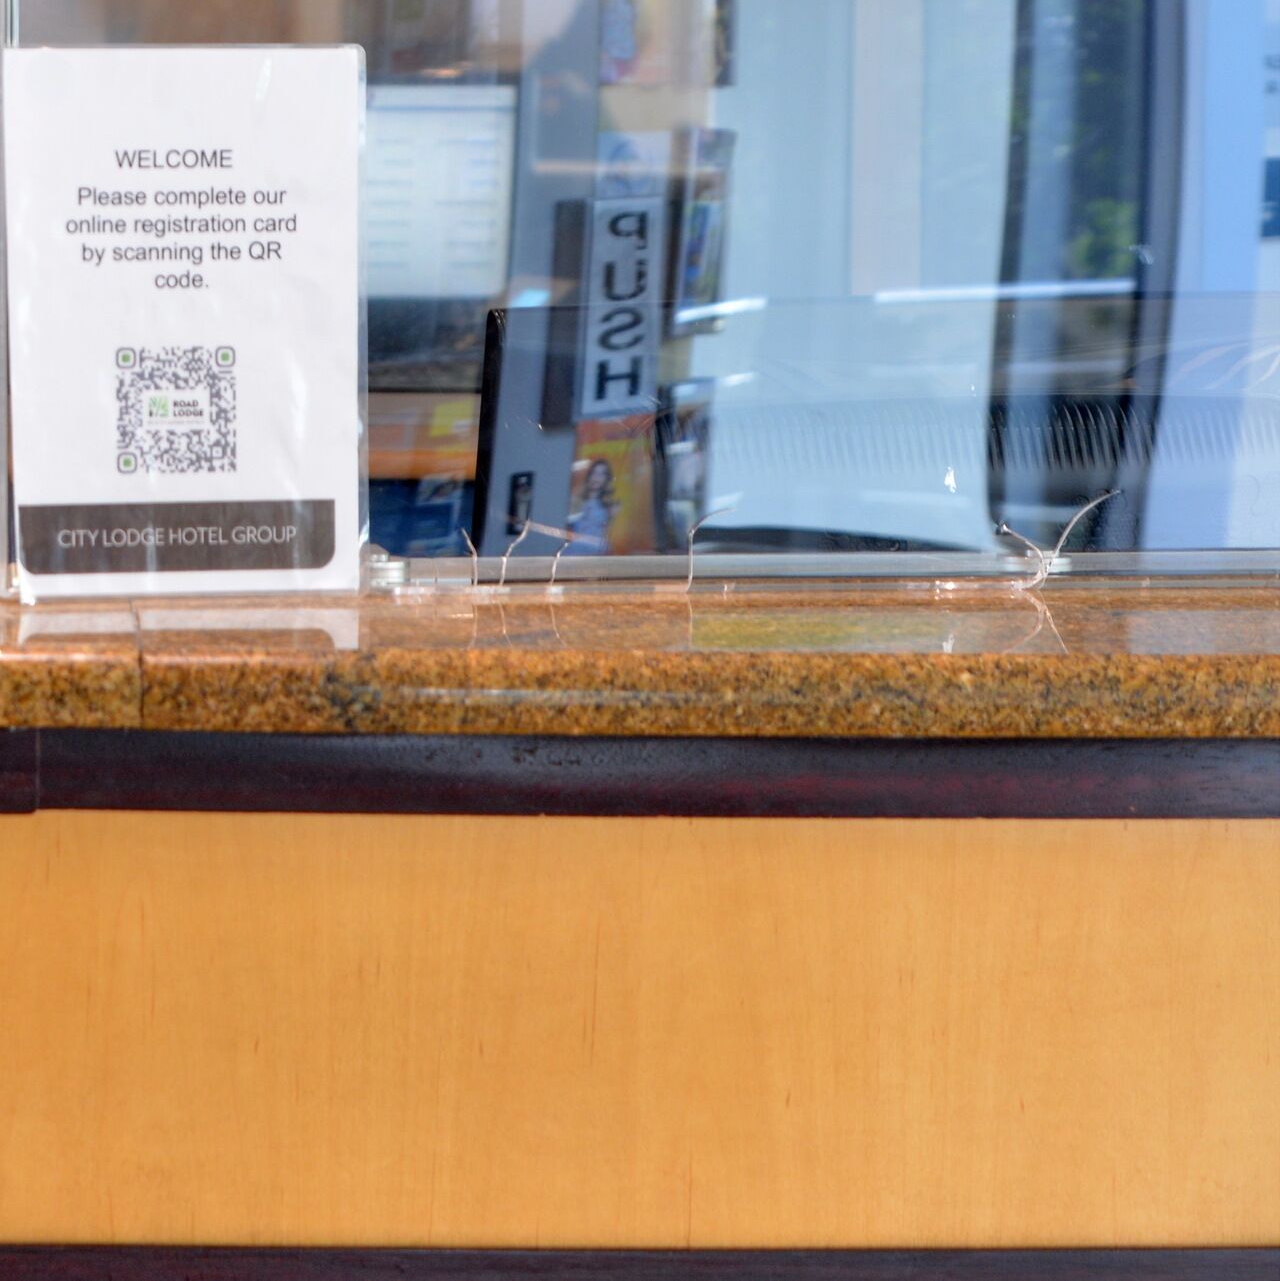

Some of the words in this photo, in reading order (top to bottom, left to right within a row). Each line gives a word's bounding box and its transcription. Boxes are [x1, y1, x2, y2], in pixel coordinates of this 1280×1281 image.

[115, 149, 233, 169] WELCOME
[77, 187, 147, 206] Please
[154, 186, 246, 209] complete
[253, 189, 287, 205] our
[65, 215, 127, 234] online
[134, 214, 246, 237] registration
[253, 214, 297, 232] card
[82, 244, 105, 266] by
[112, 242, 203, 264] scanning
[211, 242, 242, 260] the
[248, 241, 282, 260] QR
[154, 271, 209, 289] code.
[173, 399, 199, 408] ROAD
[173, 409, 204, 417] LODGE
[57, 529, 100, 548] CITY
[102, 528, 165, 547] LODGE
[168, 527, 228, 546] HOTEL
[231, 525, 297, 544] GROUP
